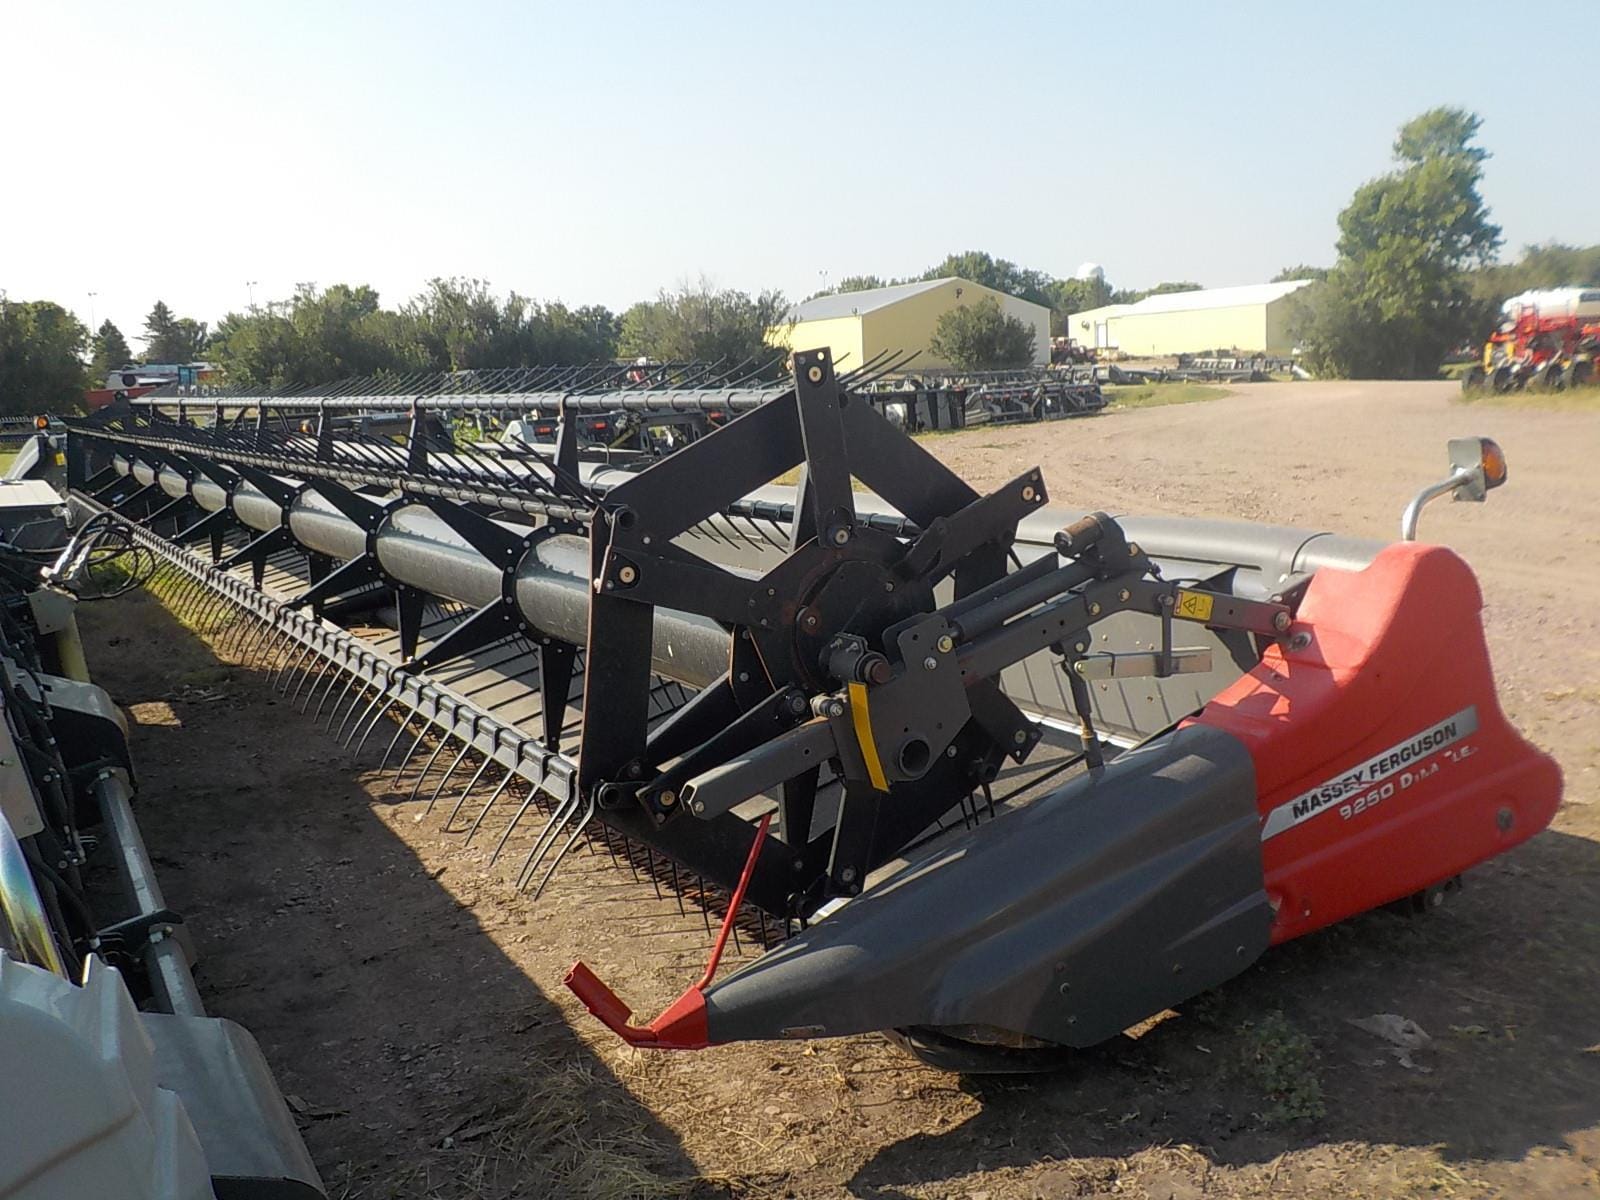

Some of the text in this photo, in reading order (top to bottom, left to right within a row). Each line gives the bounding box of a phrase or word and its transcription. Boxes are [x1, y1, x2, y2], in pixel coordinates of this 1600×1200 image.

[1292, 722, 1457, 819] MASSEY FERGUSON
[1339, 781, 1394, 820] 9250
